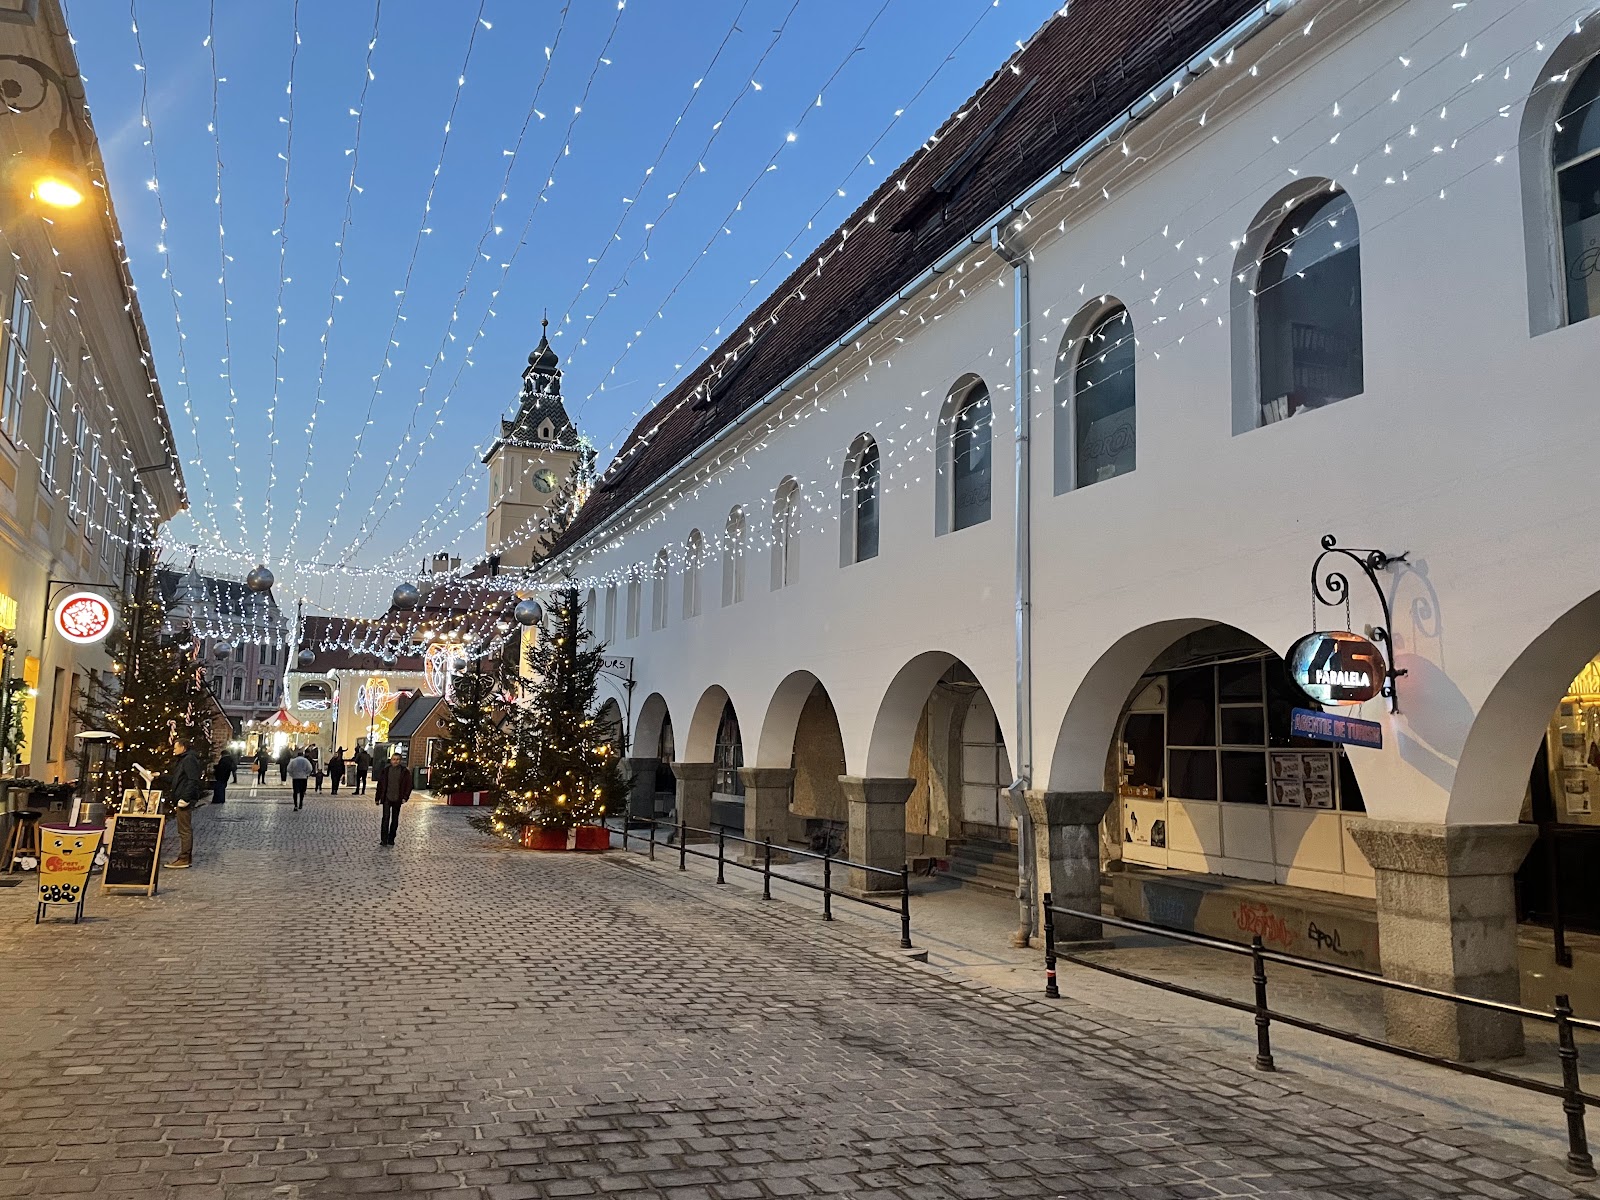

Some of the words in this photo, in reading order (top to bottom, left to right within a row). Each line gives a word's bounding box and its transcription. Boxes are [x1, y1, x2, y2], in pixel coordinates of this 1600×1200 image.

[1315, 669, 1371, 687] PARALELA
[1333, 720, 1346, 738] DE
[1346, 722, 1380, 744] TURISM
